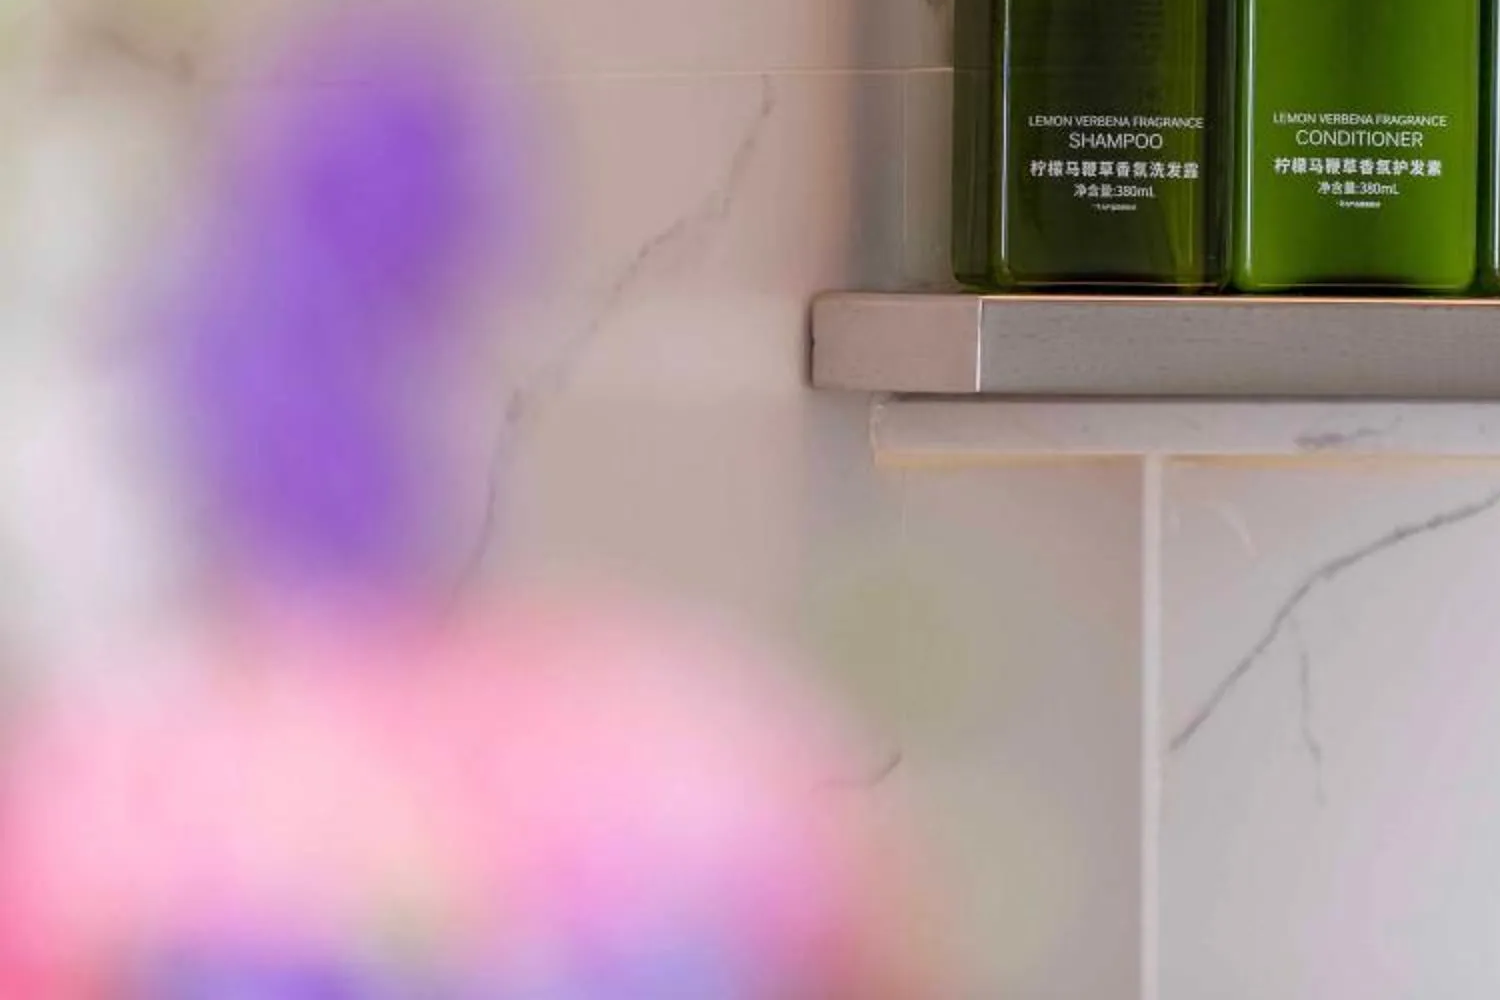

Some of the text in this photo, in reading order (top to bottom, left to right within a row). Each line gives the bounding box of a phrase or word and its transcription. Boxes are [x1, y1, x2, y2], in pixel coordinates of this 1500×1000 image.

[1028, 115, 1205, 129] LEMON VERBENA FRAGRANCE
[1273, 112, 1448, 127] LEMON VERBENA FRAGRANCE
[1068, 132, 1163, 150] SHAMPOO
[1295, 129, 1424, 147] CONDITIONER
